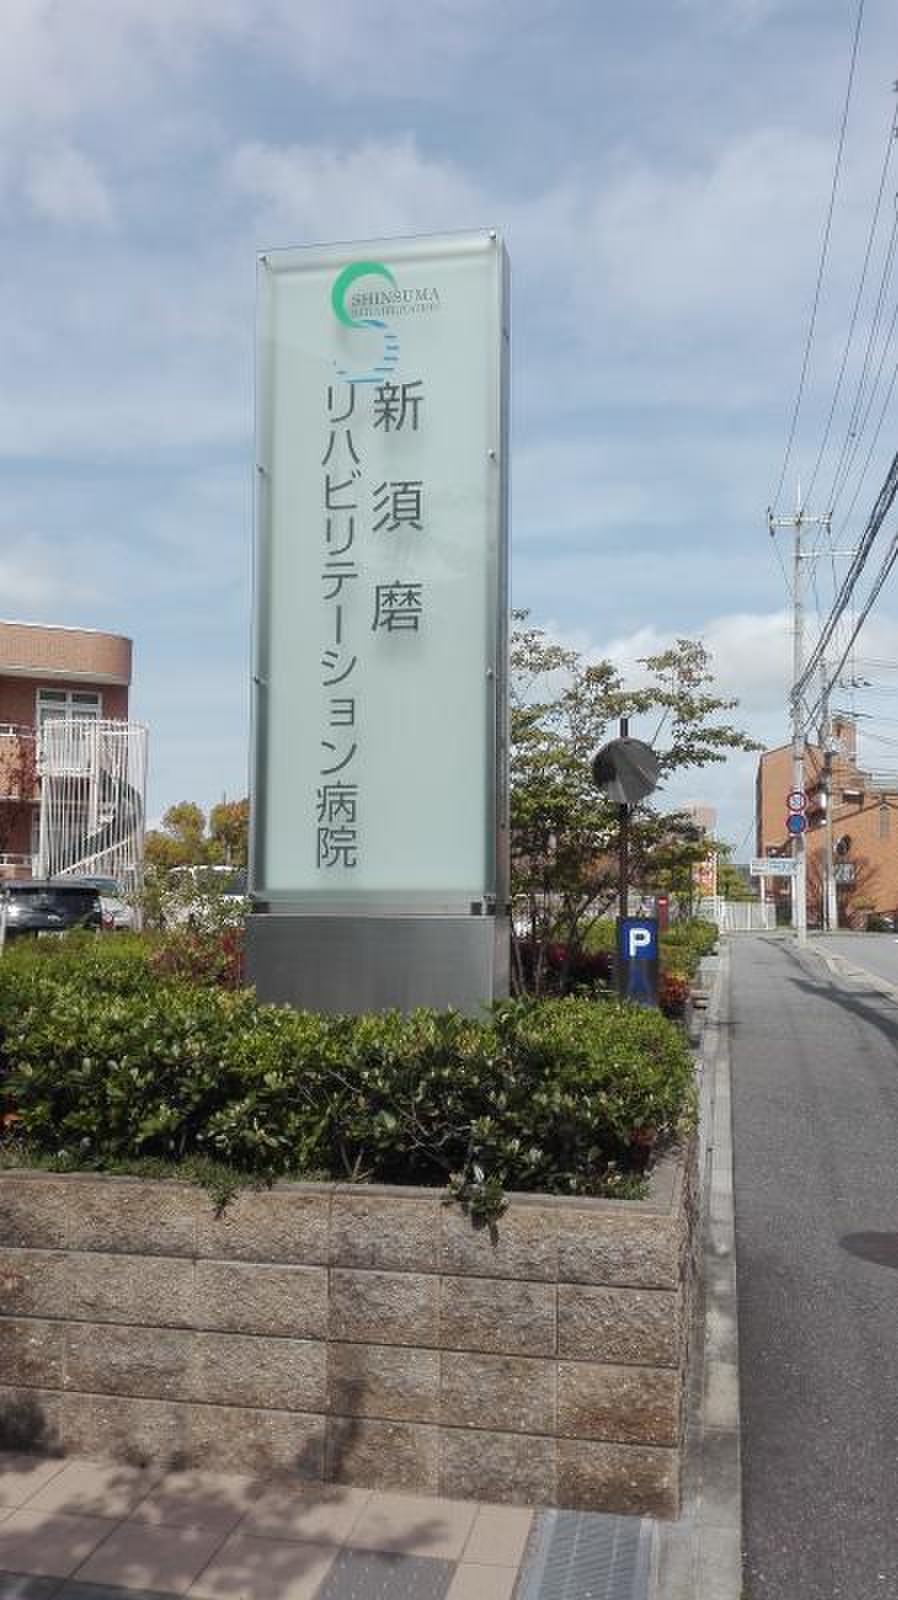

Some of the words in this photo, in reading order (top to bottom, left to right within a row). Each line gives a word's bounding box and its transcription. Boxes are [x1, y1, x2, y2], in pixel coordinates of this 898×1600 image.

[351, 288, 441, 305] SHINSUMA
[372, 380, 424, 632] 新須磨
[316, 384, 361, 869] リハビリテーション病院
[629, 927, 651, 957] P
